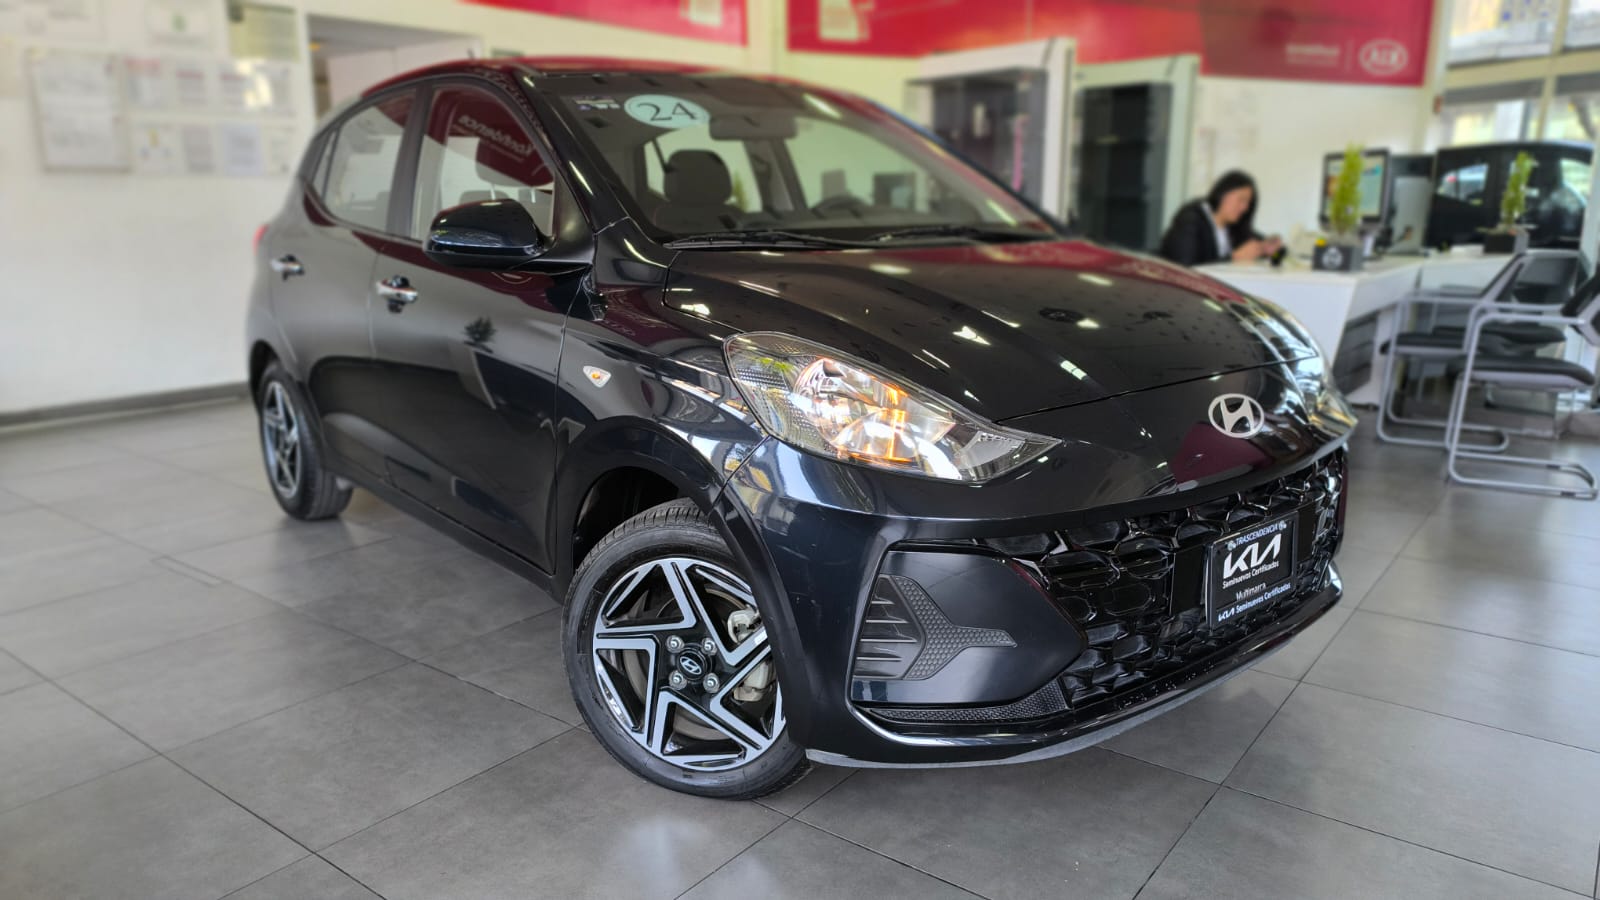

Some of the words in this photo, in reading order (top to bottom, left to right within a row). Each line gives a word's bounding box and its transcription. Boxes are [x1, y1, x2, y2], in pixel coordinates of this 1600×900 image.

[636, 102, 698, 122] 24
[1235, 523, 1279, 546] TRASCENDENCIA
[1223, 533, 1282, 579] KIA
[1222, 571, 1251, 590] Seminuevos
[1251, 560, 1280, 578] Certificados
[1235, 594, 1264, 614] Seminuevos
[1263, 582, 1292, 600] Certificados
